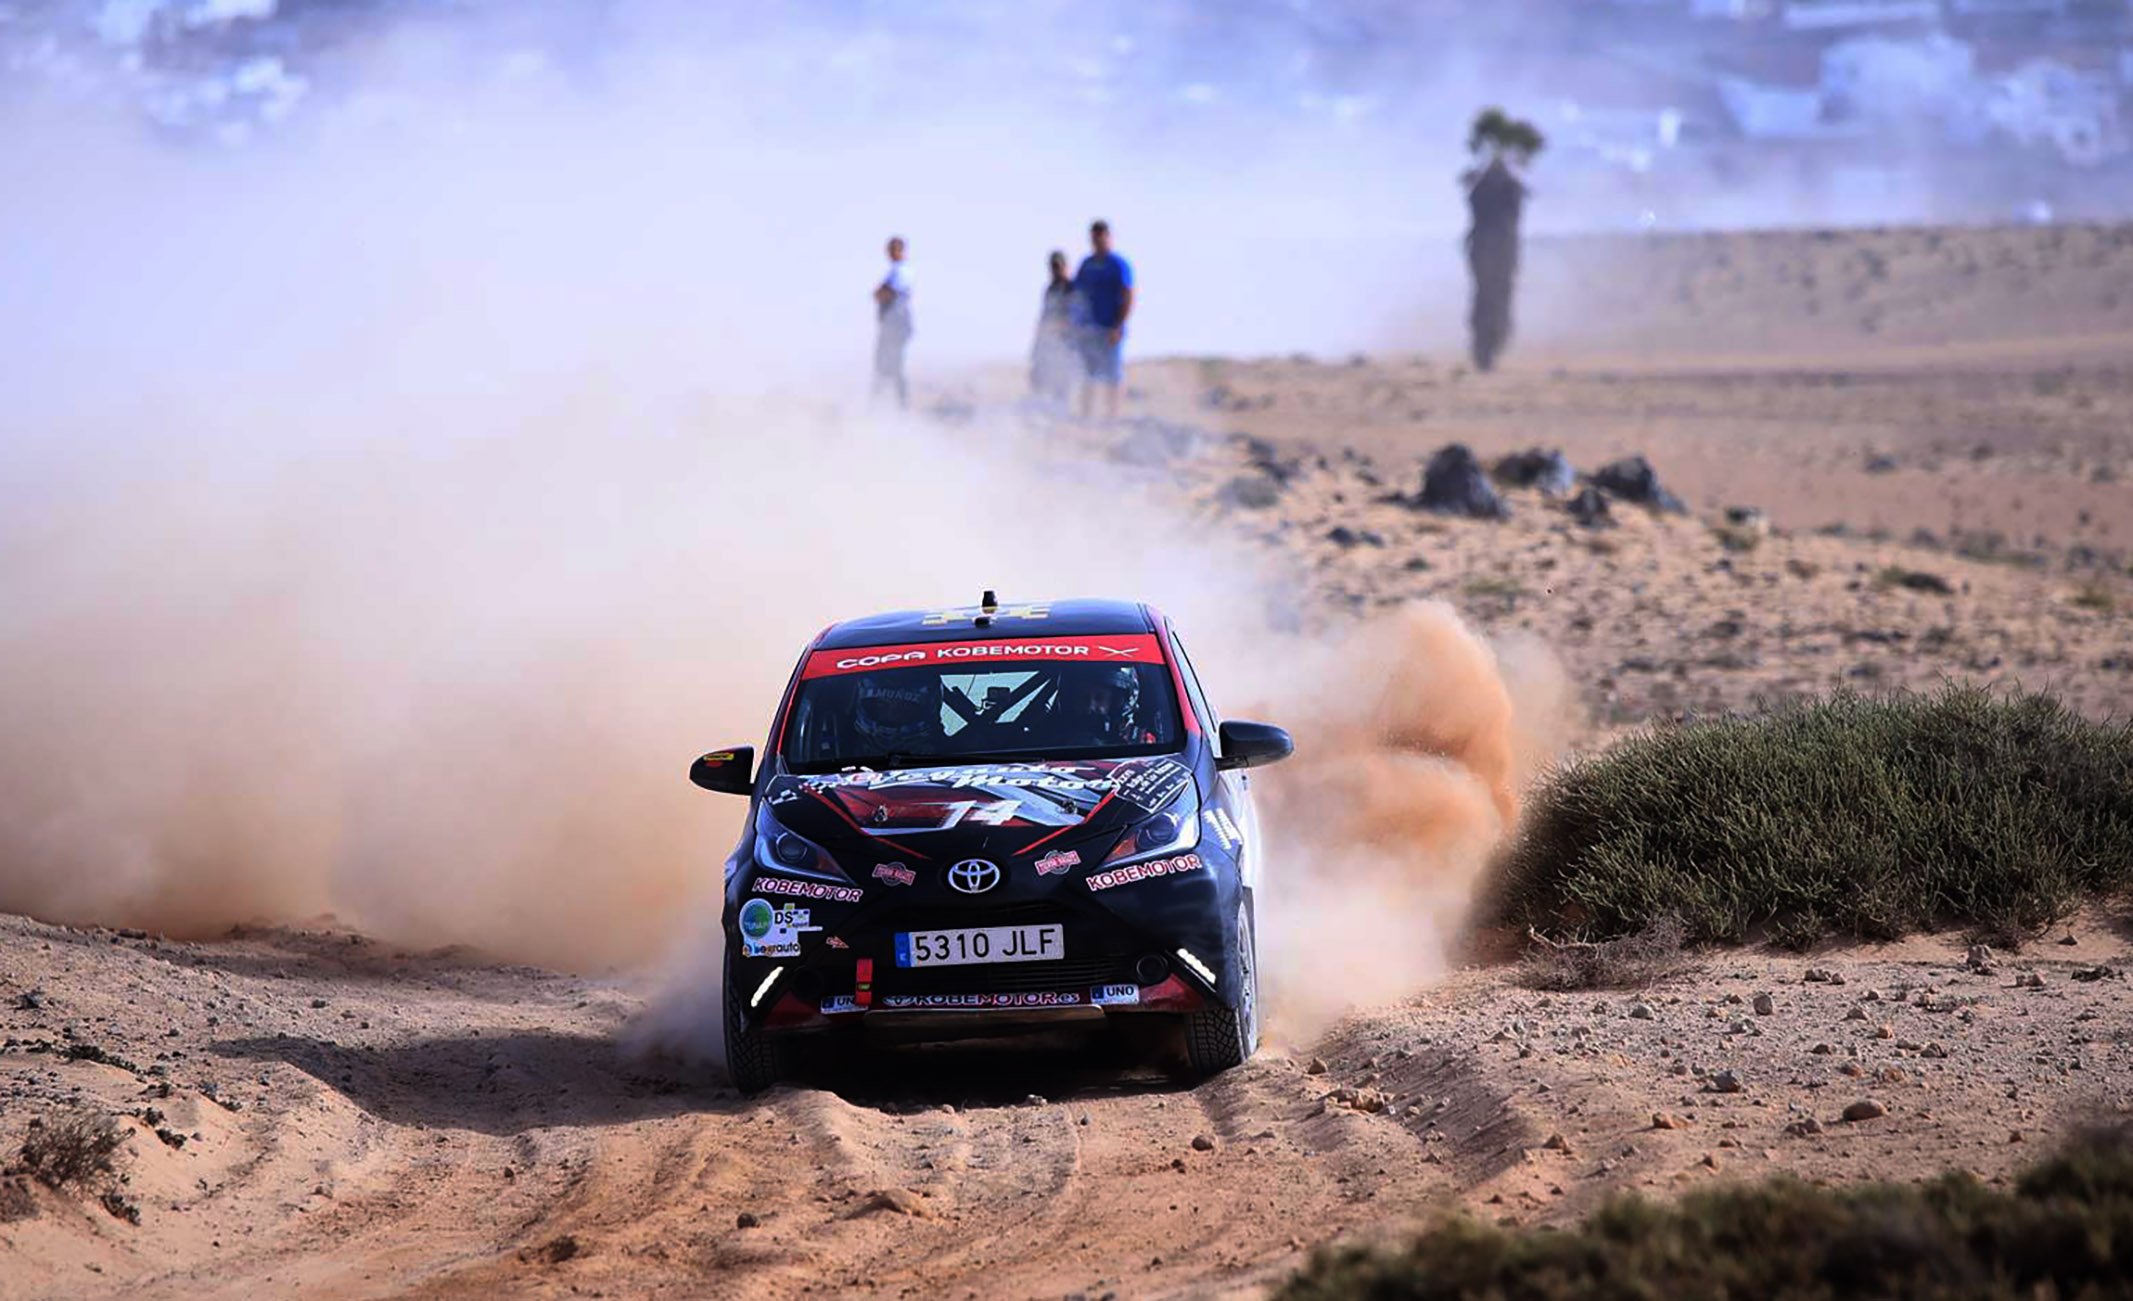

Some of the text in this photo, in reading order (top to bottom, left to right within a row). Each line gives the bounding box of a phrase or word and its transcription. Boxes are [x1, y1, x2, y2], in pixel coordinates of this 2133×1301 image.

[836, 644, 1090, 671] COPA KOBEMOTOR
[1085, 853, 1203, 893] KOBEMOTOR
[752, 877, 864, 903] KOBEMOTOR
[774, 911, 794, 925] DS
[914, 932, 990, 961] 5310
[1001, 927, 1056, 957] JLF
[1105, 985, 1135, 997] UNO
